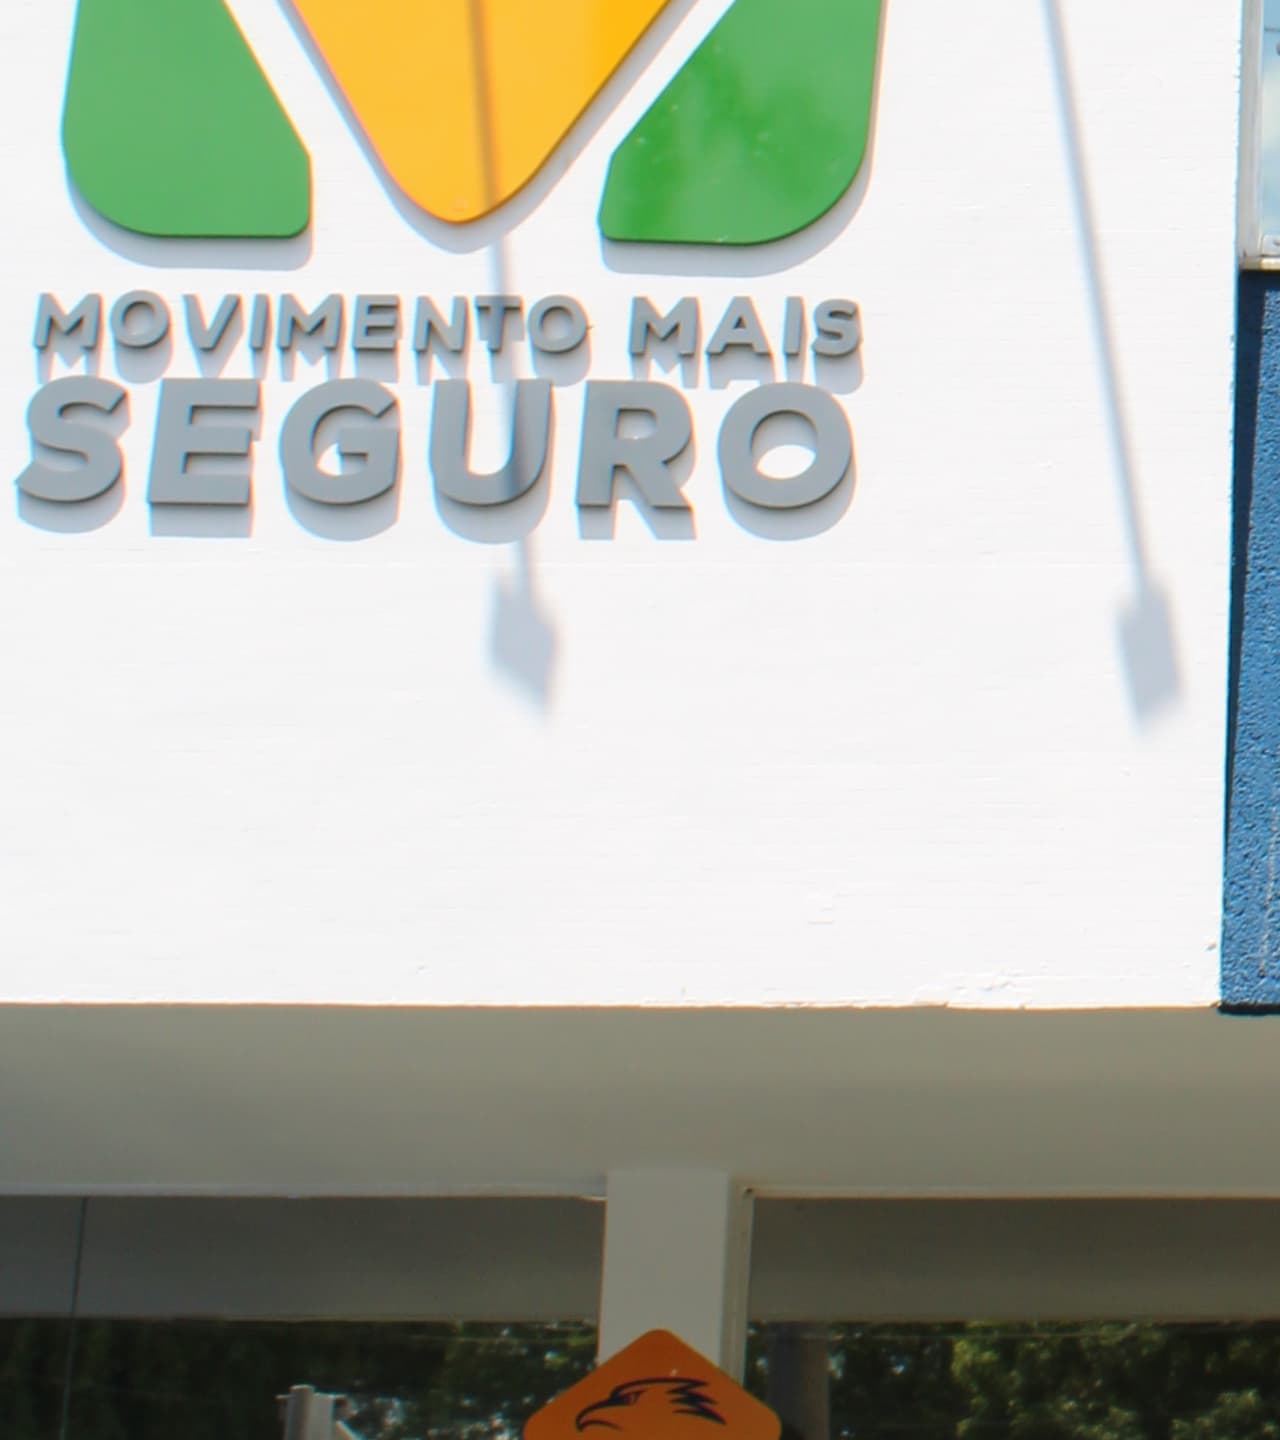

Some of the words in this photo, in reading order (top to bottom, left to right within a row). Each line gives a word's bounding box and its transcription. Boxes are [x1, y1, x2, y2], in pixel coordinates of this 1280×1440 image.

[32, 289, 590, 357] MOVIMENTO
[628, 295, 863, 359] MAIS
[15, 375, 855, 511] SEGURO
